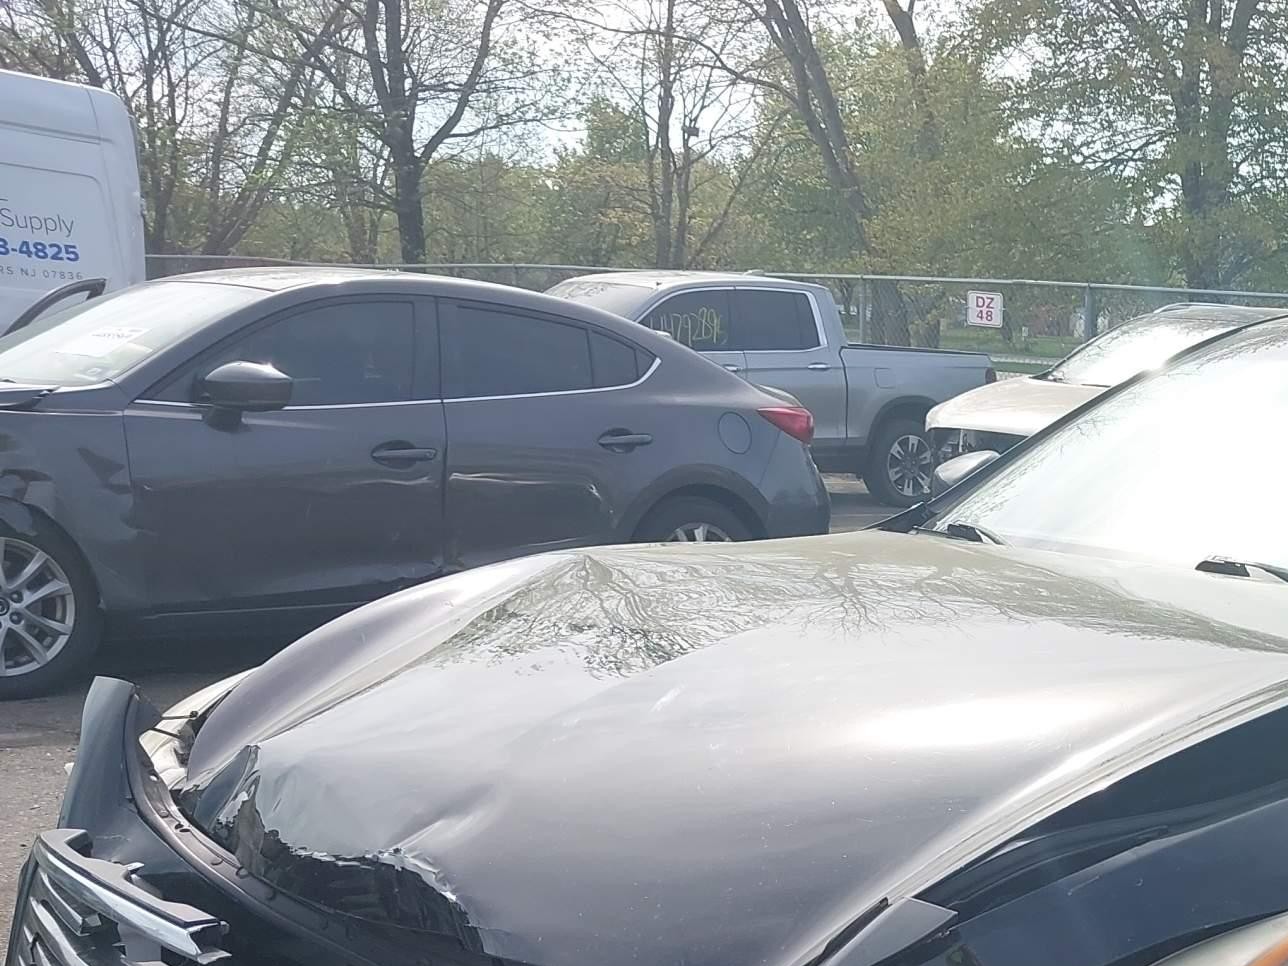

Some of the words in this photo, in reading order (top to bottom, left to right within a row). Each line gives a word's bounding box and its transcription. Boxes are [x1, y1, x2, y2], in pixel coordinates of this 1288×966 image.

[0, 207, 74, 238] Supply
[20, 267, 36, 278] NJ
[43, 269, 84, 280] 07836
[976, 295, 995, 309] DZ
[976, 310, 993, 322] 48
